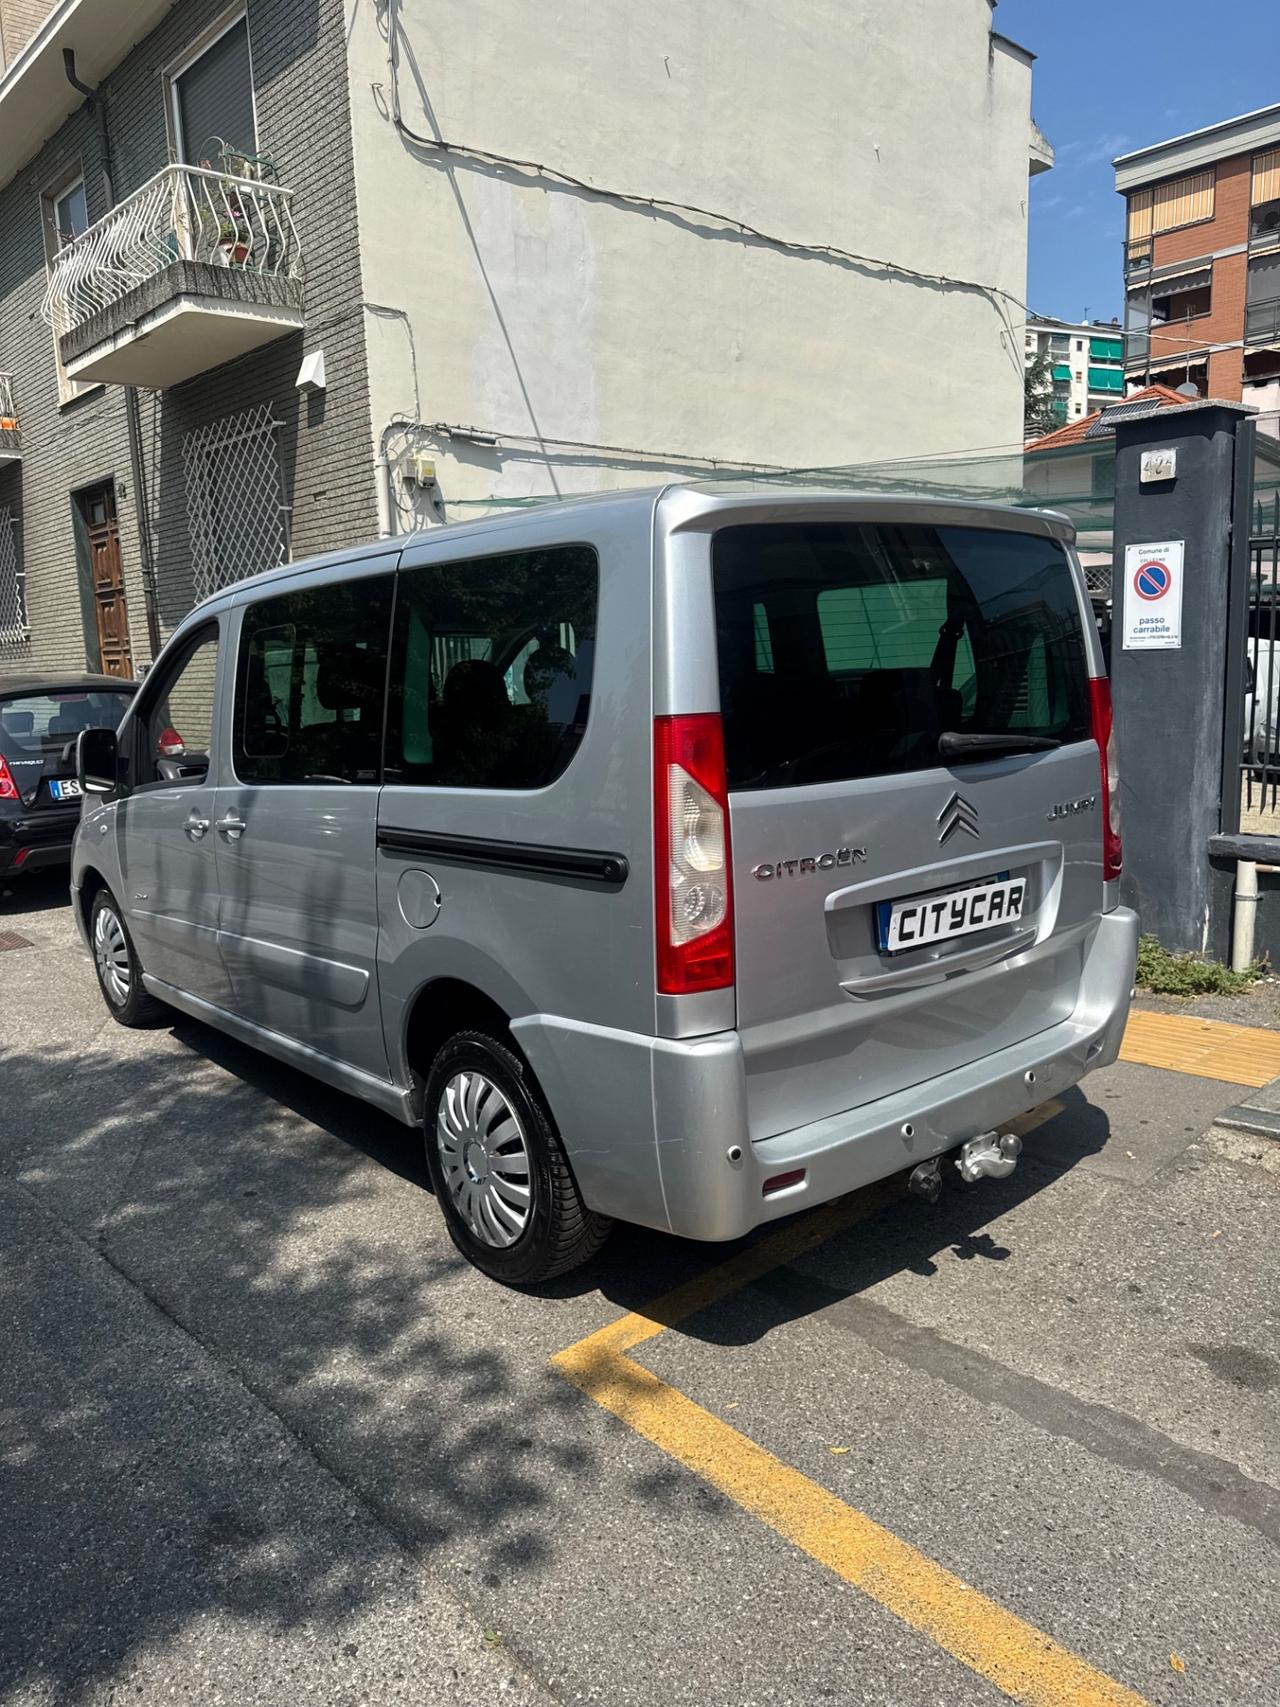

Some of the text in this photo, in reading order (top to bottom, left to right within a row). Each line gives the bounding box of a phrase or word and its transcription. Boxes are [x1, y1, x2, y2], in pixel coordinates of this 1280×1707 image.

[1133, 625, 1170, 633] carrabile
[1139, 617, 1165, 625] passo
[1046, 796, 1096, 821] JUMPY
[752, 847, 867, 881] CITROËN
[898, 885, 1023, 942] CITYCAR
